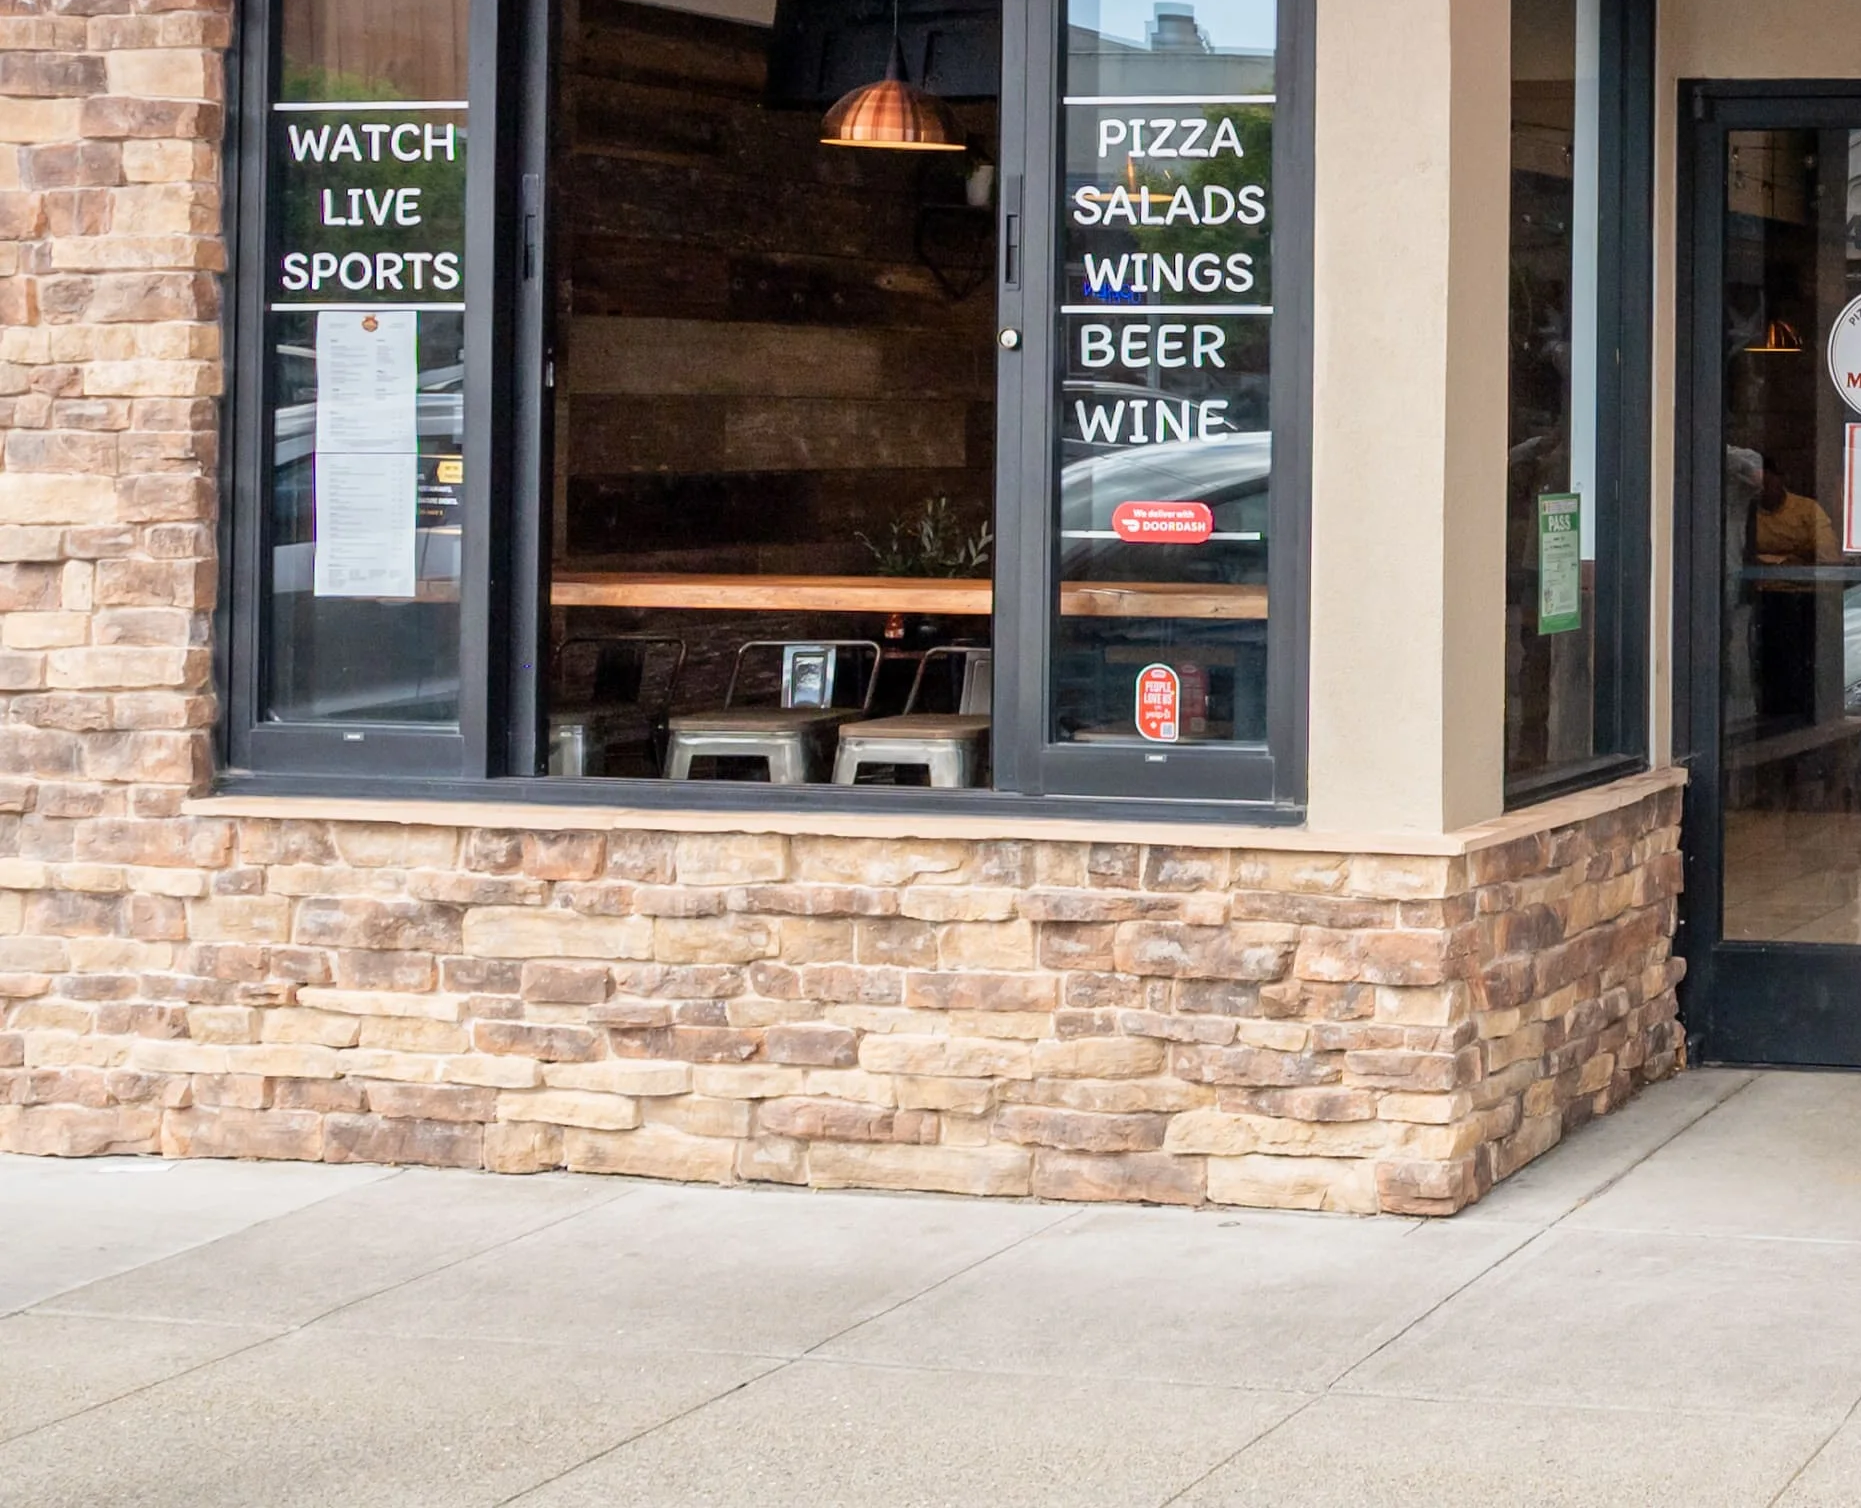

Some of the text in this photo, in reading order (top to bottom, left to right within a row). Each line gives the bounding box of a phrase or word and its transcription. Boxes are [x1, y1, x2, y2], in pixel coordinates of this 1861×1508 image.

[287, 123, 456, 162] WATCH
[1098, 117, 1244, 158] PIZZA
[321, 188, 422, 226] LIVE
[1073, 185, 1266, 225] SALADS
[282, 252, 460, 290] SPORTS
[1083, 252, 1254, 293] WINGS
[1080, 324, 1226, 368] BEER
[1074, 399, 1230, 444] WINE
[1142, 521, 1206, 532] DOORDASH
[1548, 514, 1571, 532] PASS
